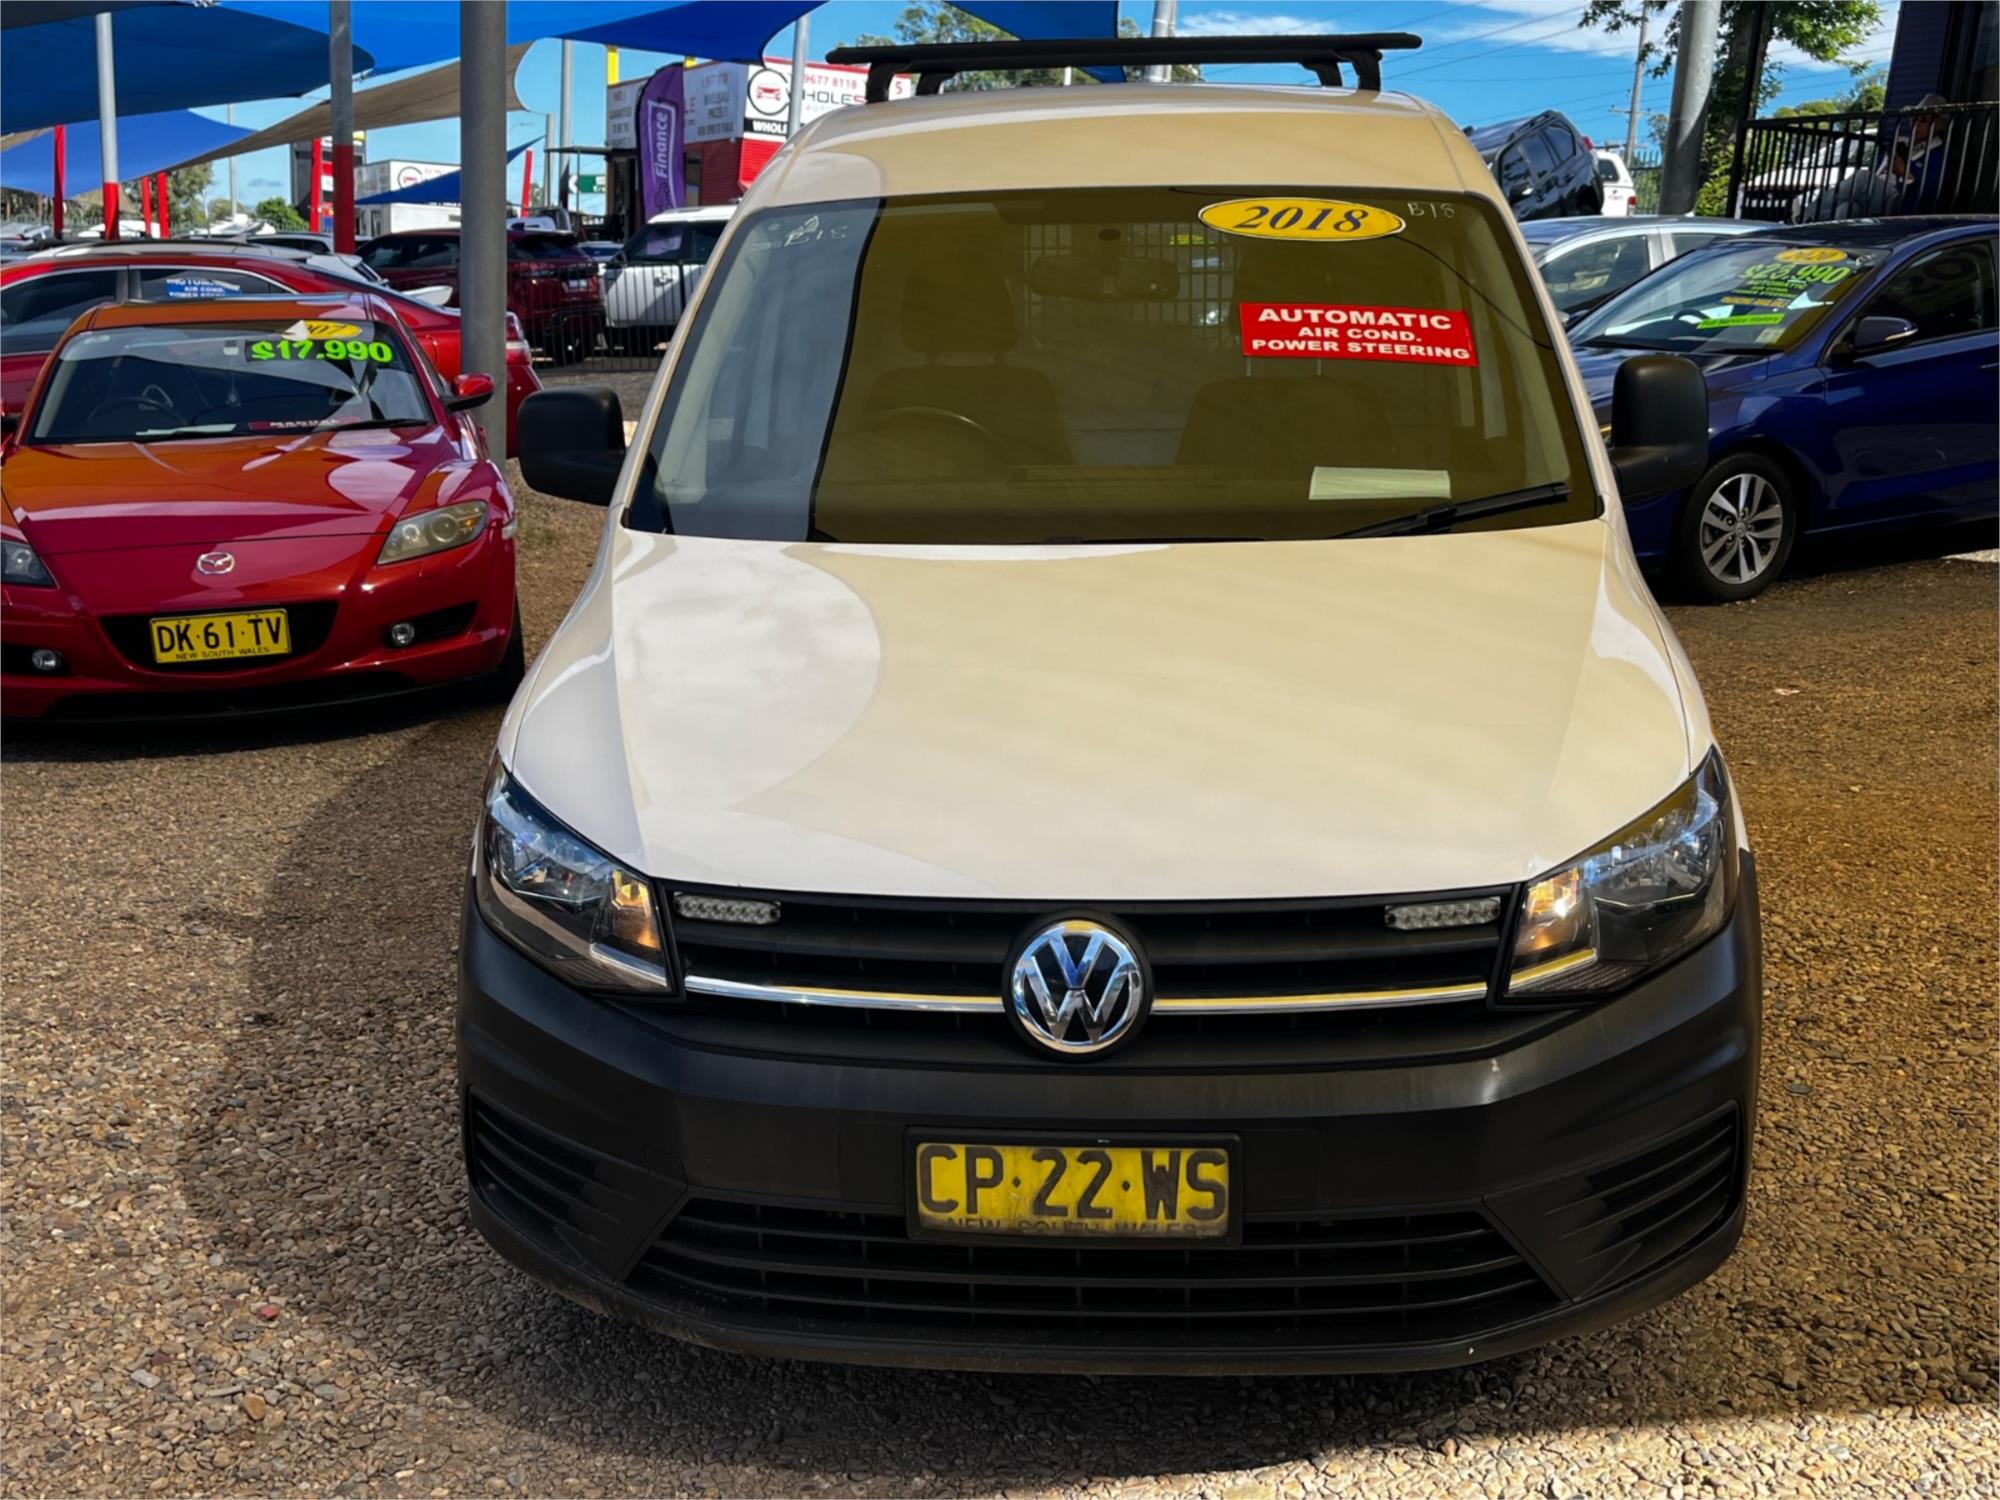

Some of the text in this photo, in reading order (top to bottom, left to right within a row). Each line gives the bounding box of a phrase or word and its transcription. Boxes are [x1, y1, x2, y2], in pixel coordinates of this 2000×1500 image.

[655, 111, 669, 178] Finance
[1233, 205, 1369, 233] 2018
[1257, 308, 1452, 330] AUTOMATIC
[1298, 327, 1422, 342] AIR COND.
[1251, 339, 1471, 360] POWER STEERING
[176, 646, 270, 661] NEW SOUTH WALES
